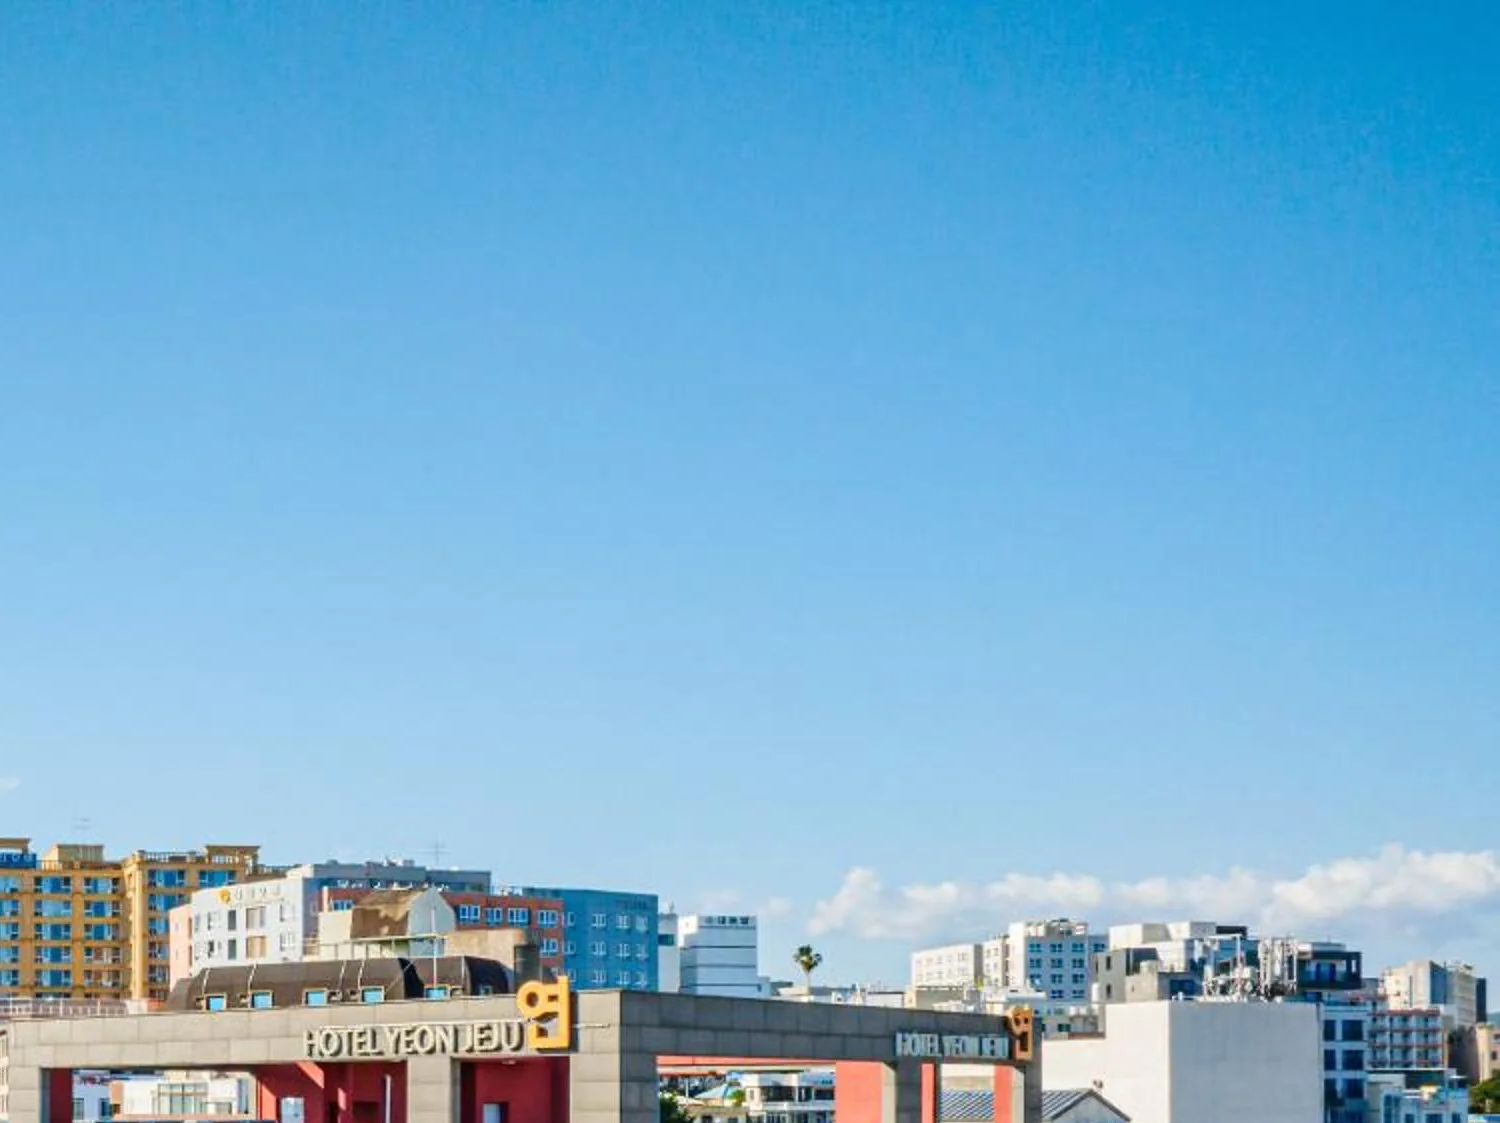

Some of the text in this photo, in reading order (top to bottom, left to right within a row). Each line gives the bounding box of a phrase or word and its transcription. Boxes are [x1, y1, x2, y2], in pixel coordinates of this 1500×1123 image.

[304, 1022, 523, 1056] HOTEL YEON JEJU
